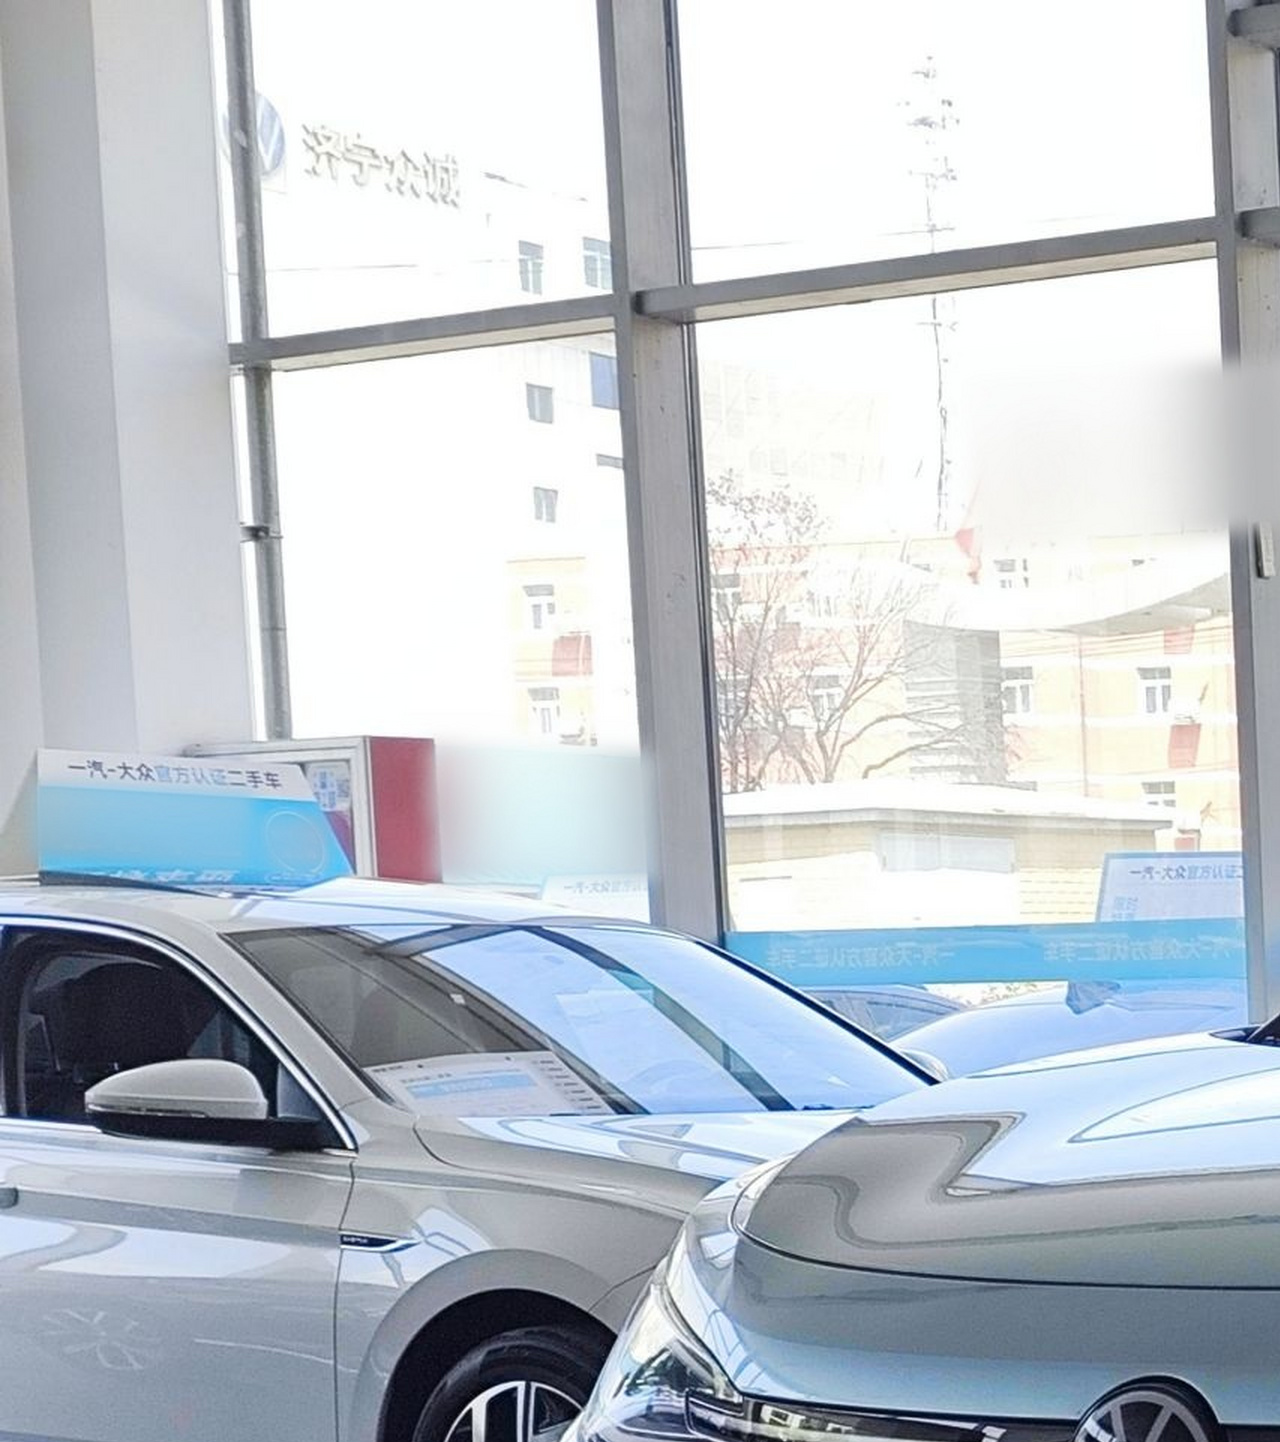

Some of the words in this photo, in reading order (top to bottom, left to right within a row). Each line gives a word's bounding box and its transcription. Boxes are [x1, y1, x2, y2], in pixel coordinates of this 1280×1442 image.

[67, 759, 282, 789] 一汽-大众官方认证二手车
